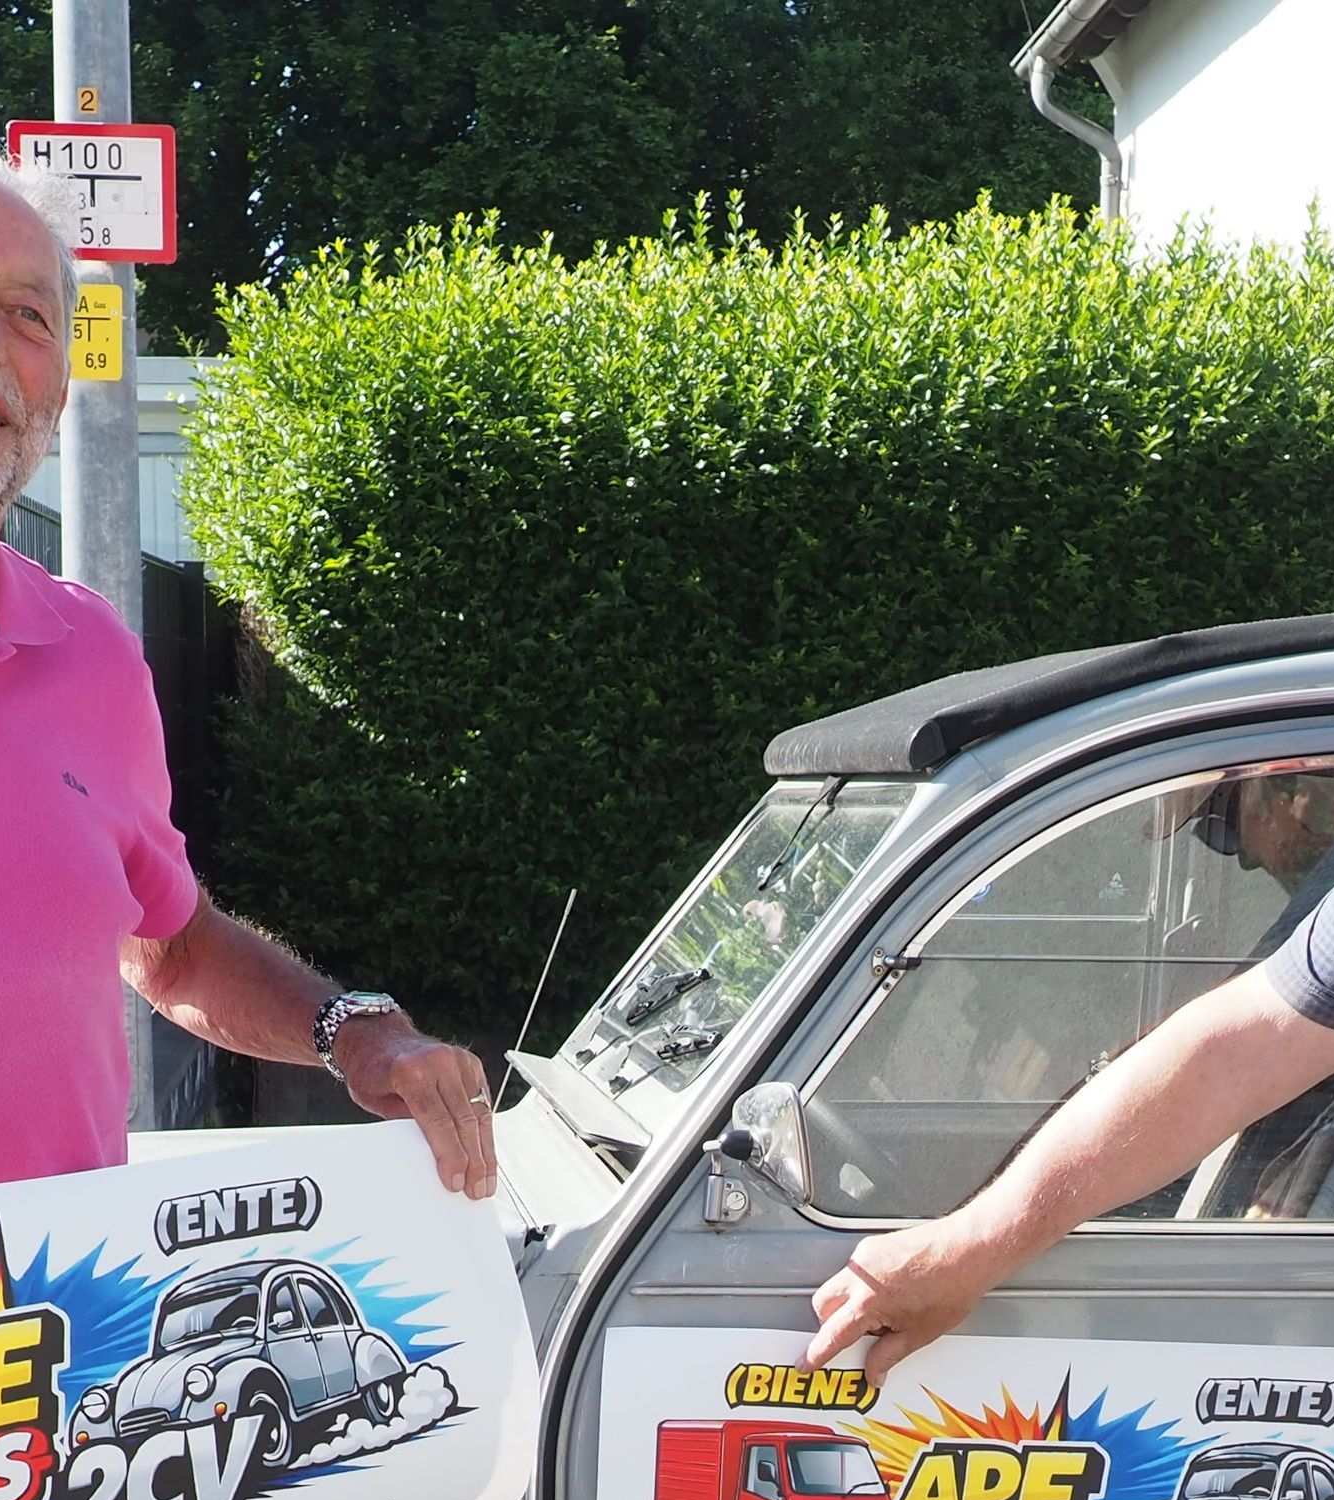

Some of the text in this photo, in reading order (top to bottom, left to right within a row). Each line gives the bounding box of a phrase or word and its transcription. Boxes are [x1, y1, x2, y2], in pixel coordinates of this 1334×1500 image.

[80, 89, 95, 112] 2
[74, 295, 89, 313] A
[85, 352, 107, 370] 6,9
[156, 1177, 319, 1252] (ENTE)
[726, 1364, 877, 1412] (BIENE)
